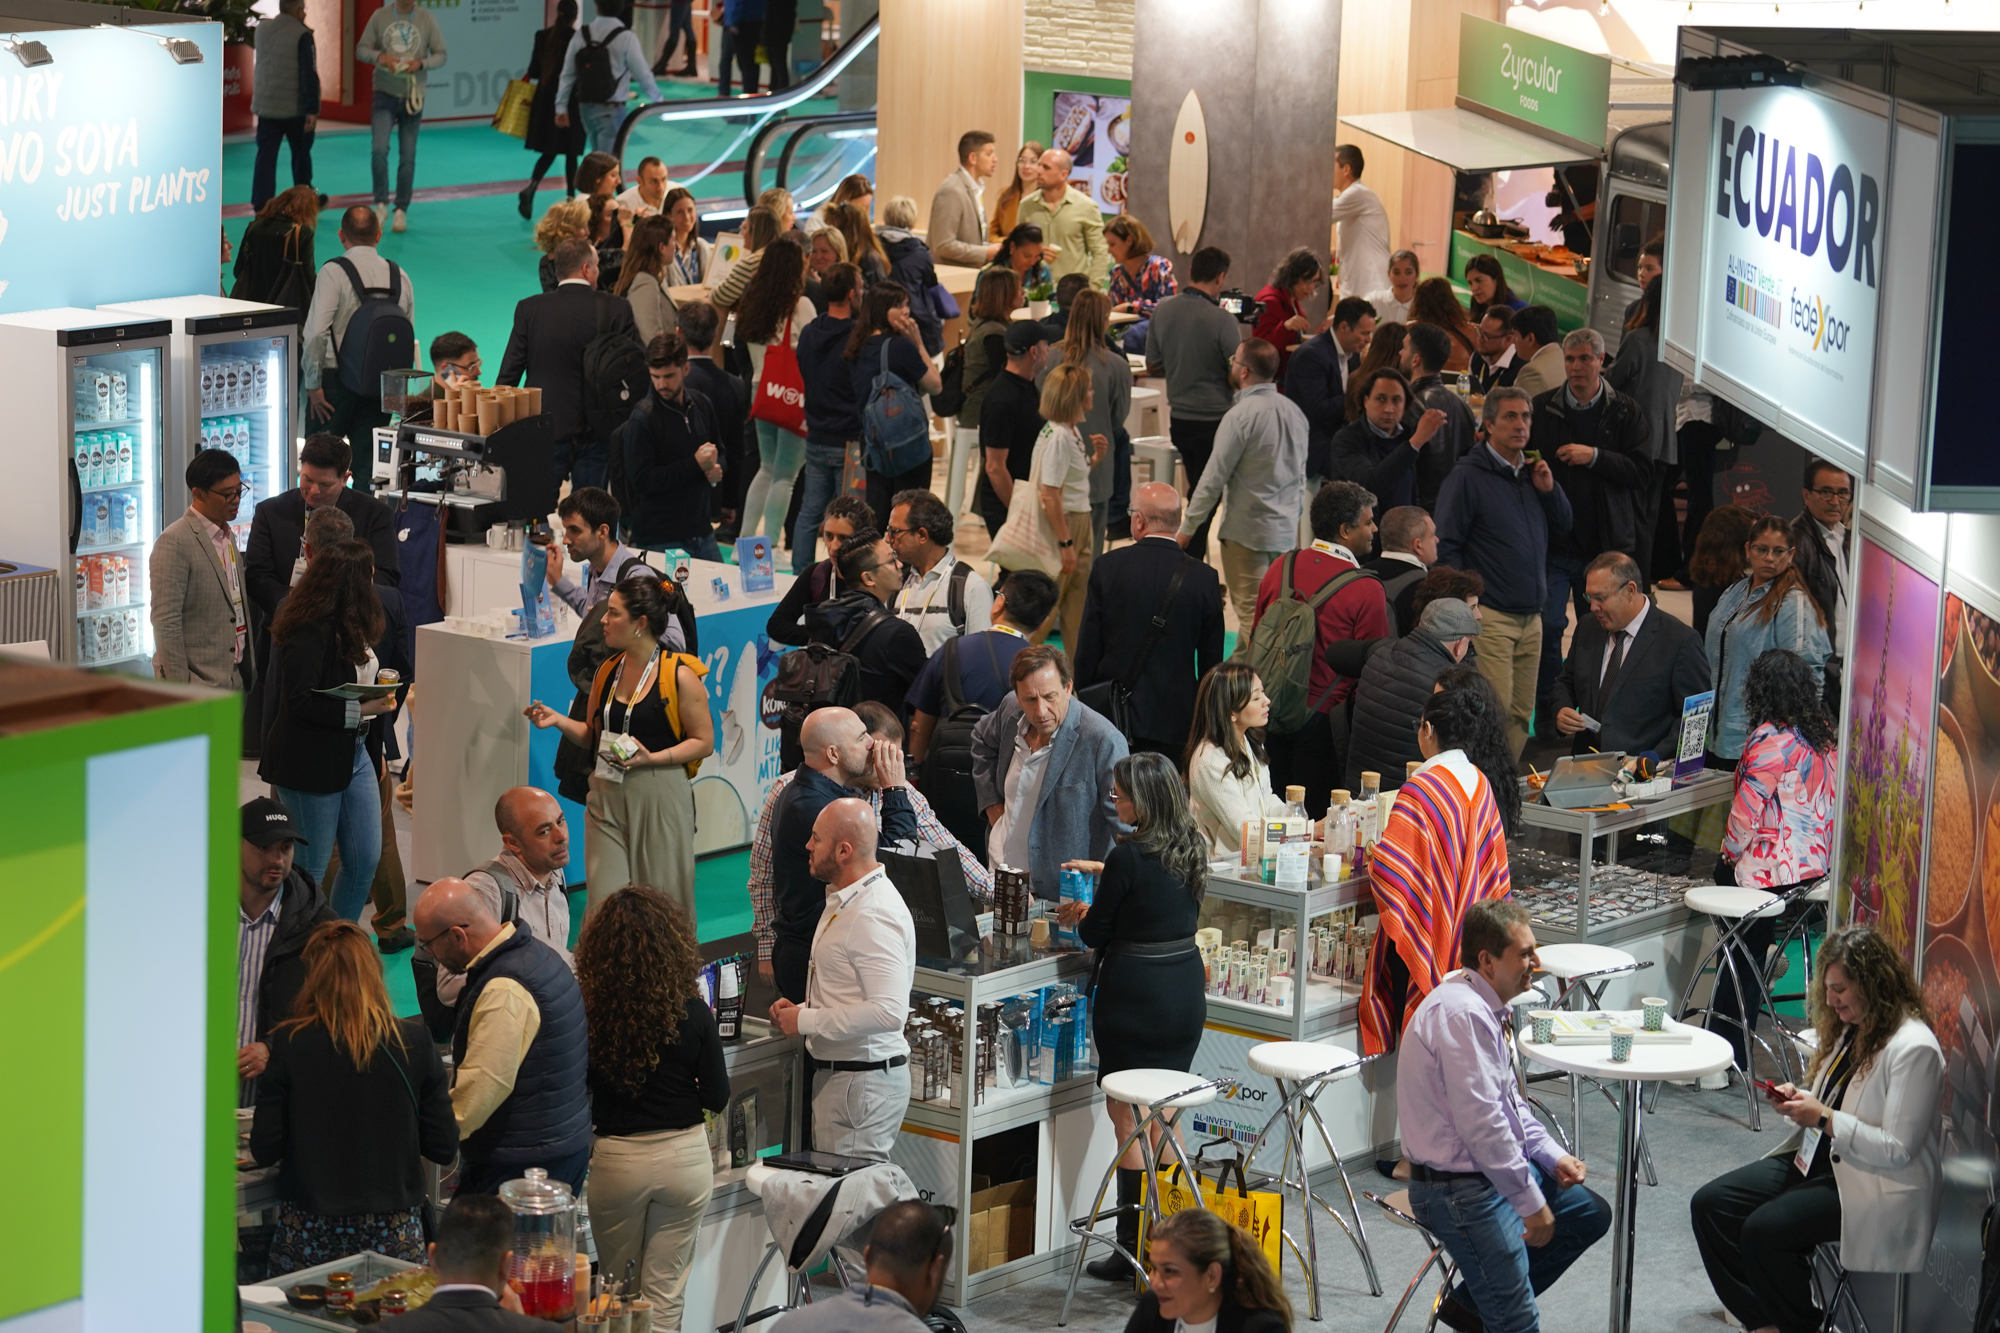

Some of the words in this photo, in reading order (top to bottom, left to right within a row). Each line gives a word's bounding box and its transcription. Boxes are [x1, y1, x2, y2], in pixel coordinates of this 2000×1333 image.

[1520, 95, 1538, 112] FOODS
[55, 117, 138, 176] SOYA
[56, 182, 122, 222] JUST
[128, 167, 210, 214] PLANTS
[1717, 116, 1879, 289] ECUADOR
[1727, 253, 1757, 284] AL-INVEST
[1757, 268, 1775, 294] Verde
[763, 695, 788, 715] kok
[765, 735, 781, 755] LIK
[758, 755, 781, 784] MIL
[265, 814, 288, 822] HUGO
[1193, 1113, 1232, 1128] AL-INVEST
[1234, 1121, 1256, 1133] Verde
